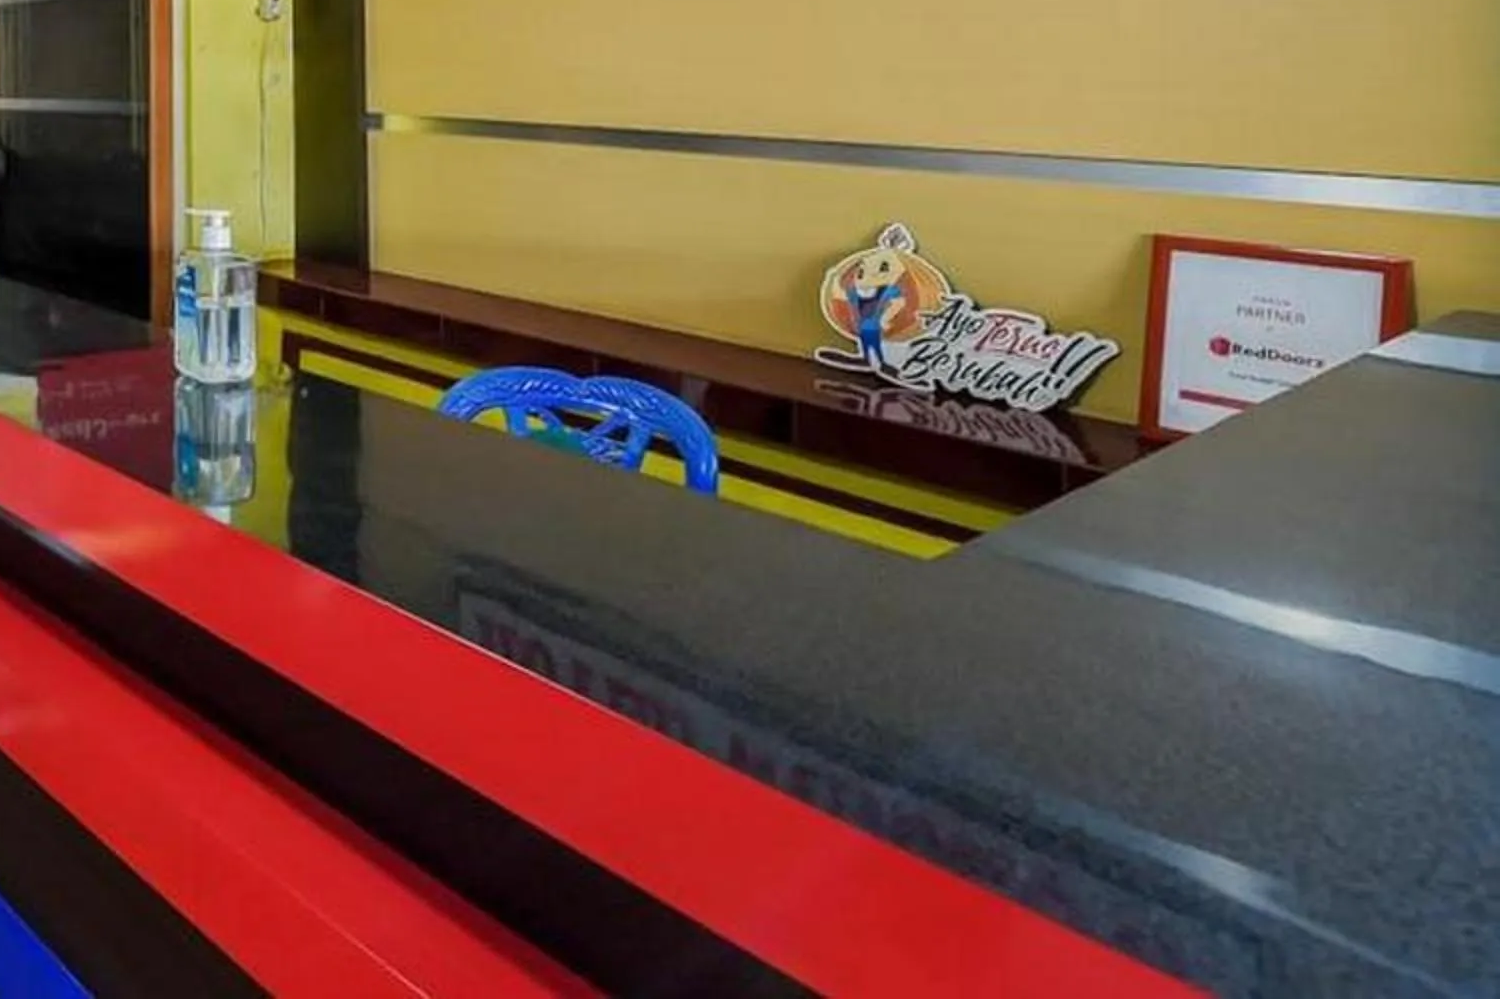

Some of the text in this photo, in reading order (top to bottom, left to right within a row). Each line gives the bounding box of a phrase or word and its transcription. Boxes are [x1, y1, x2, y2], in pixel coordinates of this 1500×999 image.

[920, 297, 1059, 359] Ayo Terus
[1236, 304, 1306, 326] PARTNER
